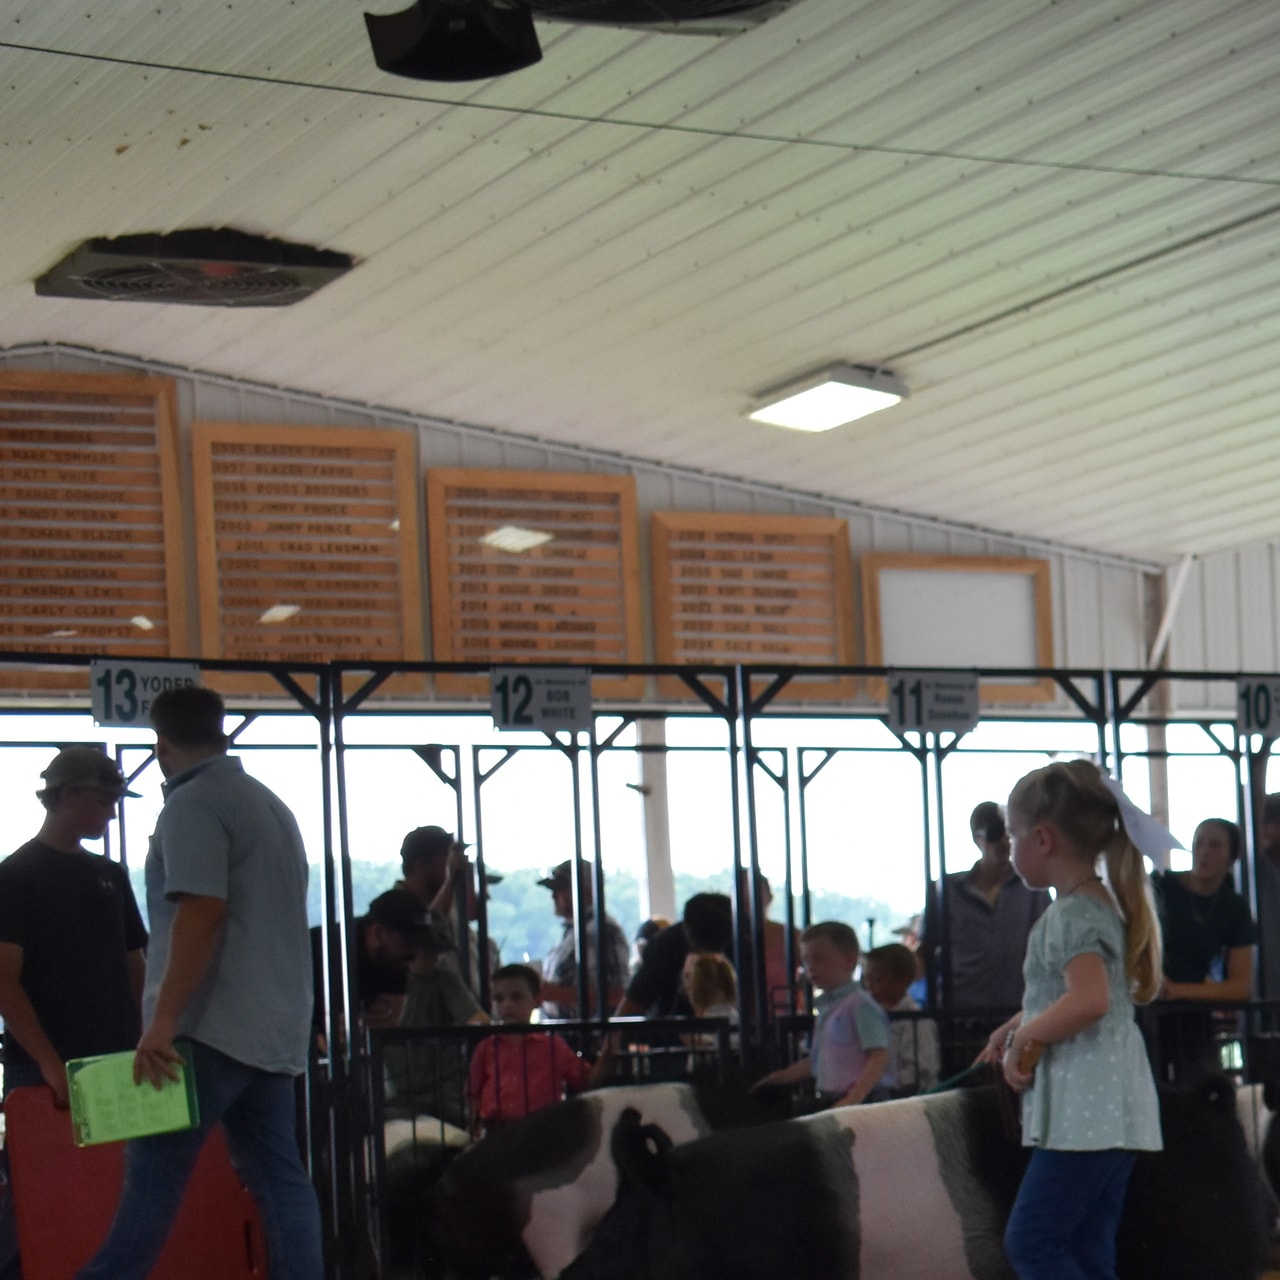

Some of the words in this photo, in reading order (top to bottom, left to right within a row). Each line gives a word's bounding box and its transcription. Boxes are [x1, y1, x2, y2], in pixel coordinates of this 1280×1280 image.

[97, 669, 139, 722] 13
[495, 674, 532, 724] 12
[541, 706, 576, 719] WHITE
[892, 679, 922, 726] 11
[1240, 683, 1271, 730] 10
